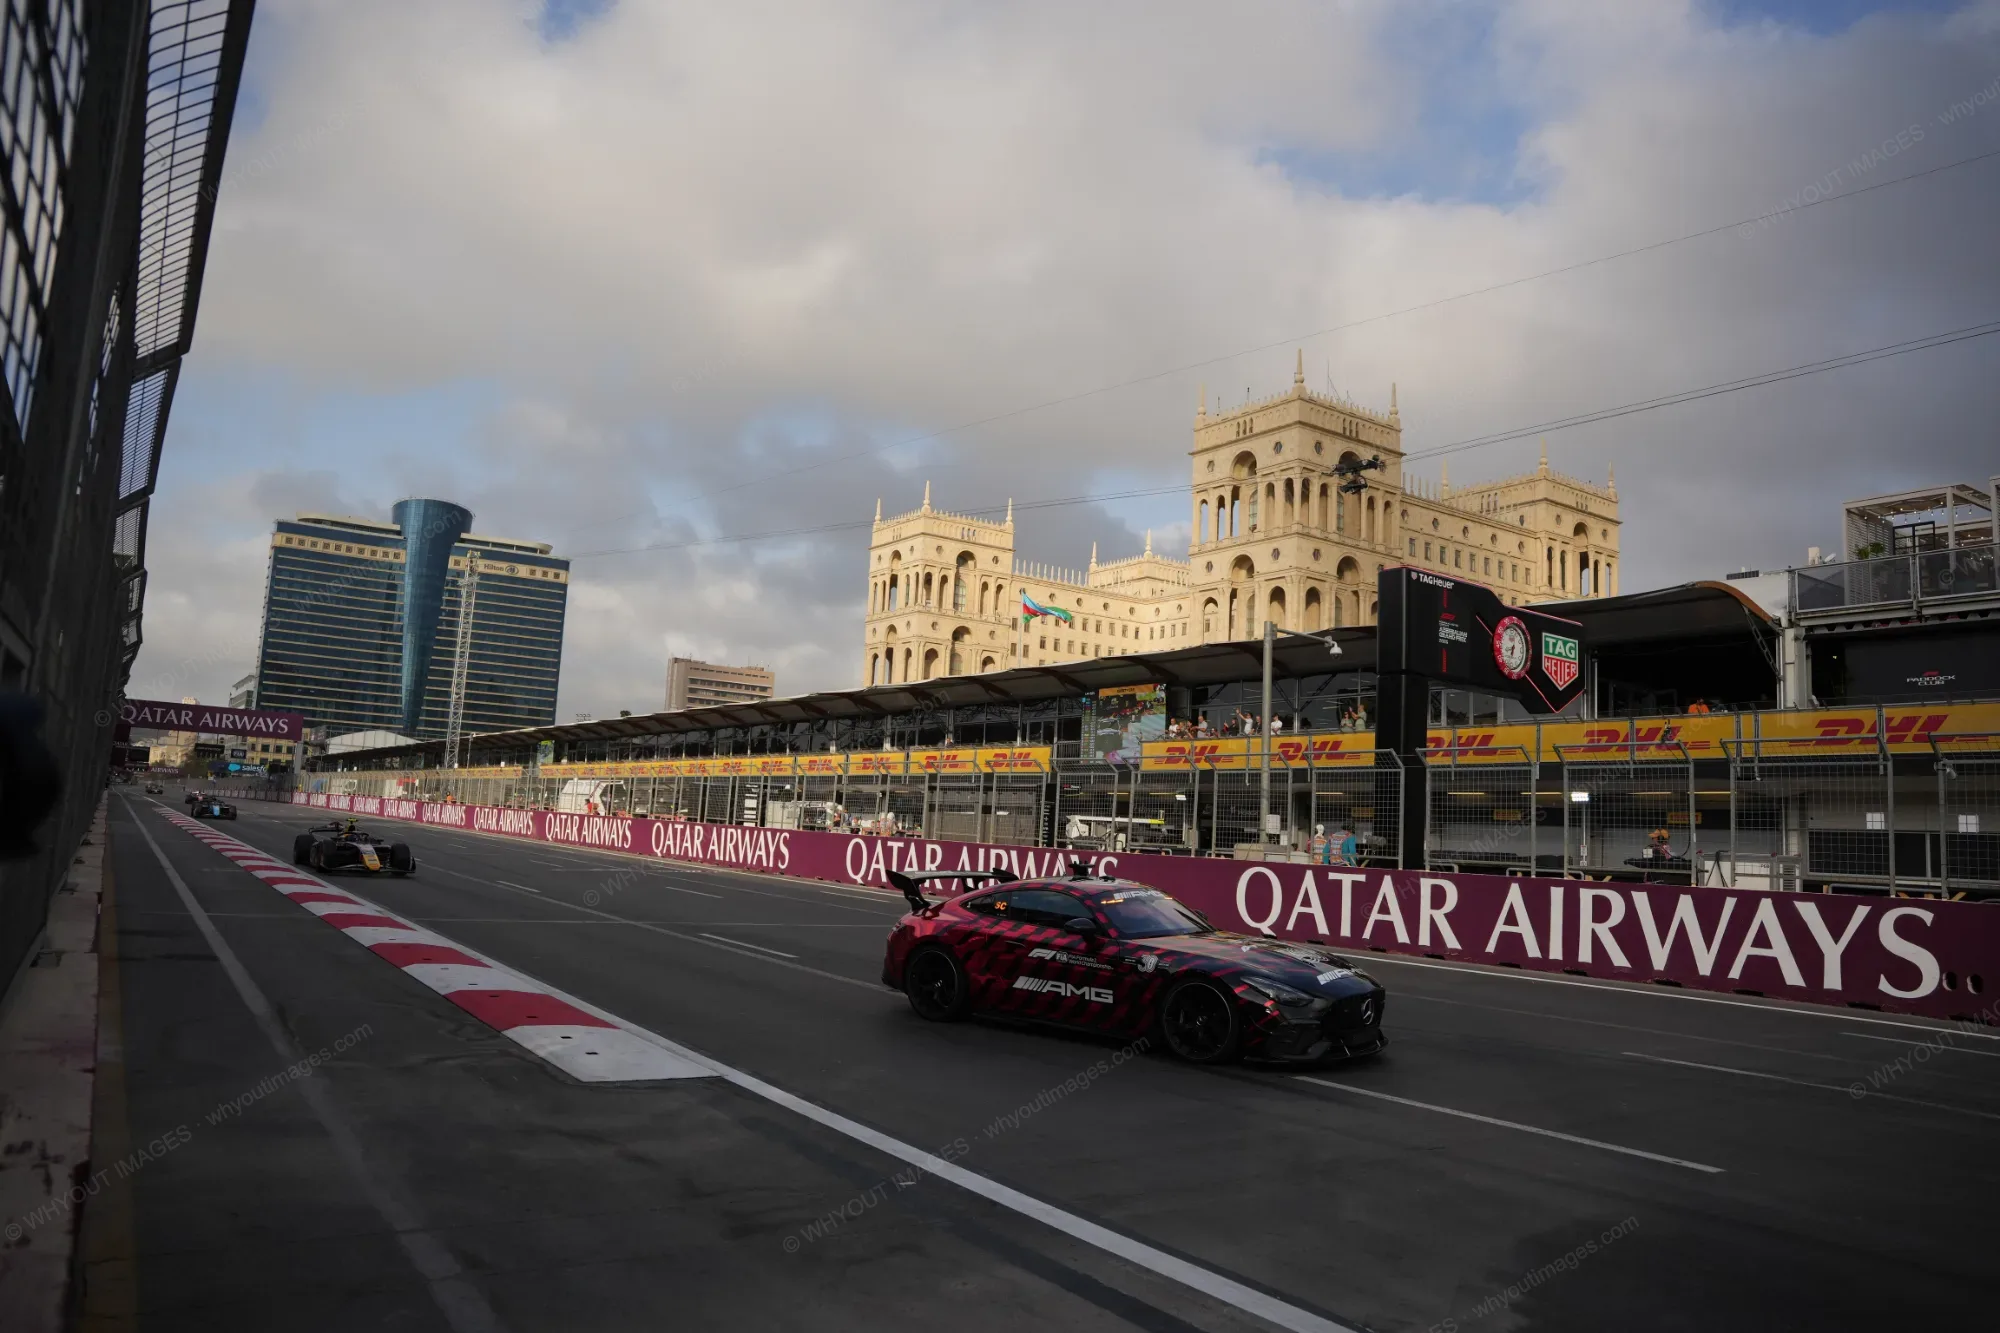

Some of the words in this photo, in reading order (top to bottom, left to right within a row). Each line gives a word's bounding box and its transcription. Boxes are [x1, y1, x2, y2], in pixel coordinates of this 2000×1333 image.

[484, 563, 504, 572] Hilton
[1546, 637, 1576, 658] TAG
[1544, 656, 1577, 687] HEUER
[120, 704, 193, 726] QATAR
[199, 712, 289, 734] AIRWAYS
[1813, 714, 1957, 746] DHL
[1277, 740, 1346, 761] DHL
[1426, 734, 1502, 758] DHL
[1576, 725, 1686, 753] DHL
[925, 755, 959, 769] DHL
[992, 752, 1033, 767] DHL
[1163, 745, 1227, 764] DHL
[383, 799, 398, 817] QATAR
[398, 800, 417, 819] AIRWAYS
[422, 803, 440, 823] QATAR
[440, 804, 466, 826] AIRWAYS
[473, 807, 498, 830] QATAR
[498, 809, 533, 835] AIRWAYS
[545, 813, 579, 842] QATAR
[580, 816, 632, 849] AIRWAYS
[651, 822, 705, 858] QATAR
[706, 827, 790, 869] AIRWAYS
[845, 838, 943, 890] QATAR
[951, 845, 1118, 891] AIRW
[994, 901, 1007, 910] SC
[1236, 866, 1461, 951] QATAR
[1485, 882, 1940, 1000] AIRWAYS
[1056, 952, 1068, 962] FIA
[1042, 979, 1113, 1004] AMG
